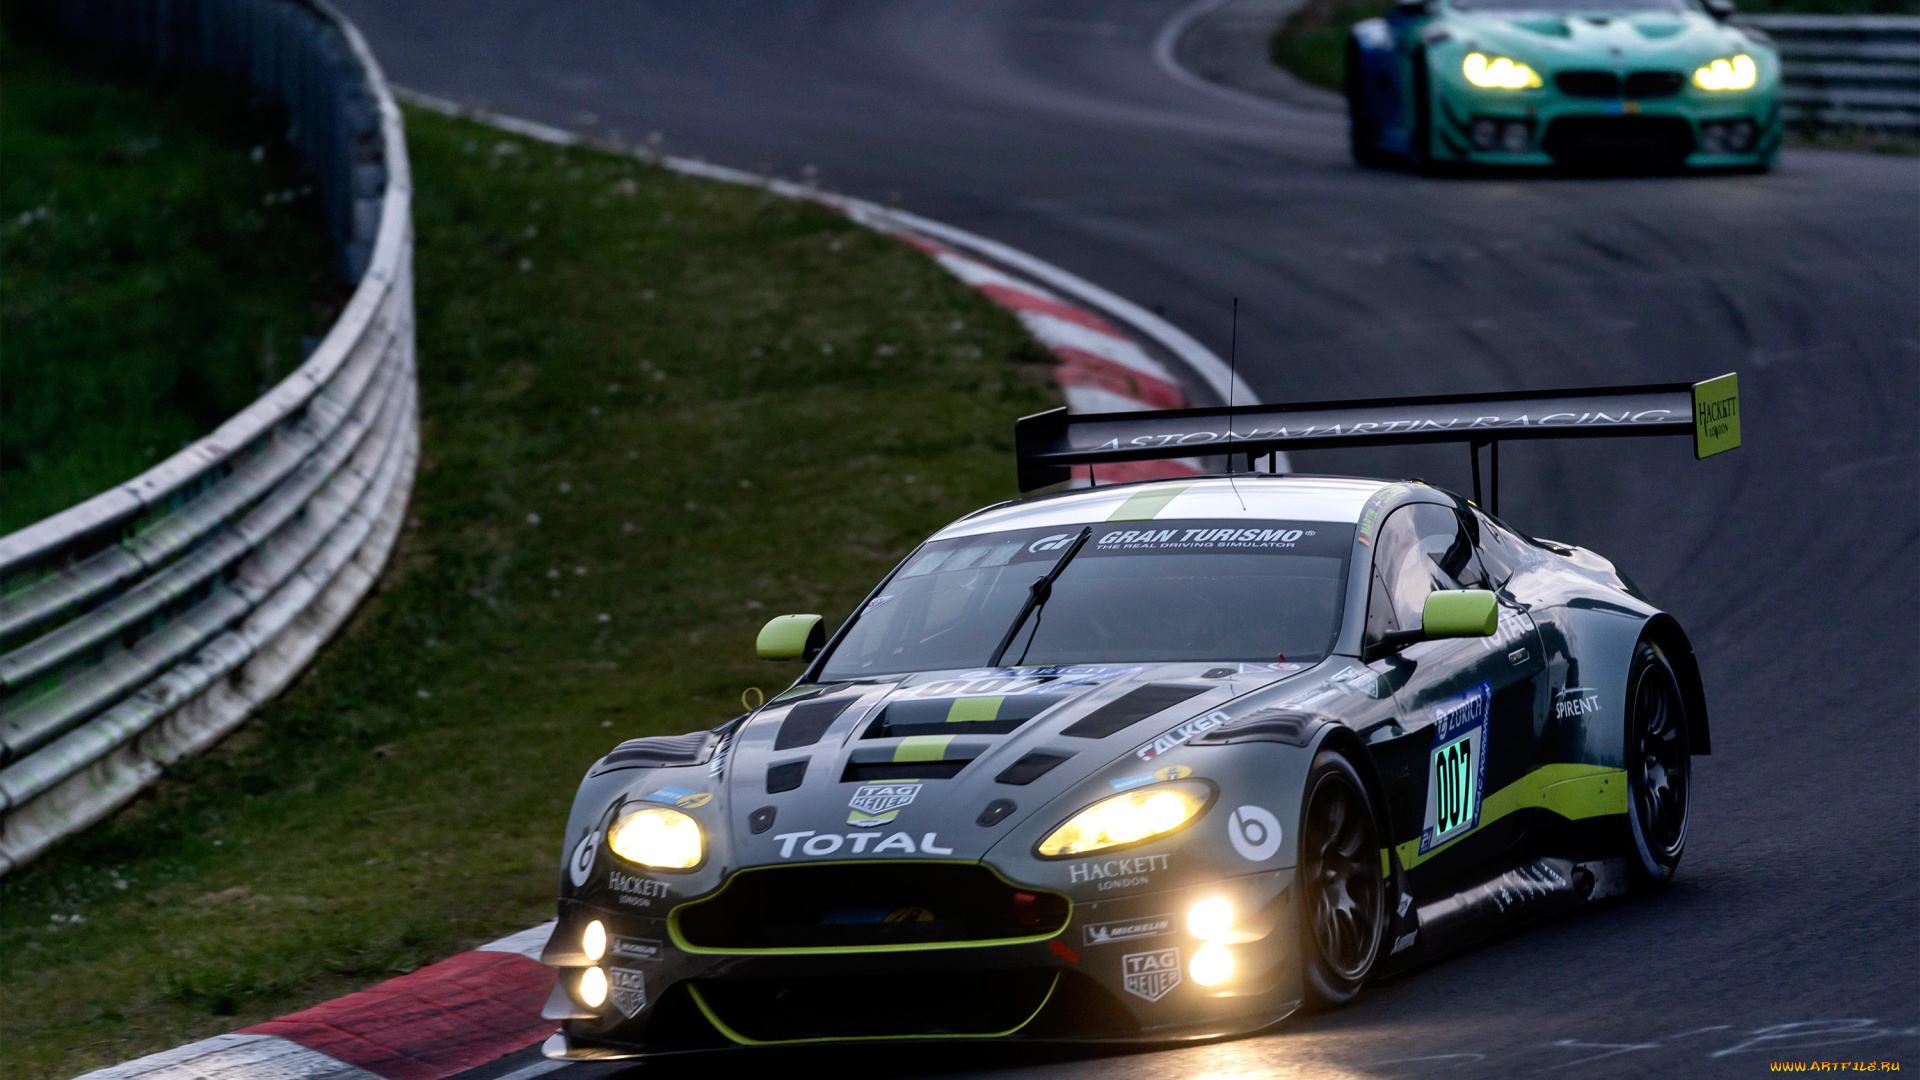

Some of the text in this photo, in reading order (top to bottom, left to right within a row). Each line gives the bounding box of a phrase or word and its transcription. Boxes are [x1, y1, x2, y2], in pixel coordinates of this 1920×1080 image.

[1698, 396, 1737, 426] HACKETT
[1098, 409, 1671, 450] ASTON MARTIN RACING
[1098, 530, 1178, 545] GRAN
[1160, 541, 1214, 549] DRIVING
[916, 676, 1062, 697] 007
[1448, 694, 1483, 731] ZURICH
[1555, 695, 1599, 719] SPIRENT
[1136, 710, 1232, 762] FALKEN
[863, 786, 914, 796] TAG
[1437, 738, 1471, 833] 007
[854, 796, 910, 811] HEUER
[772, 829, 954, 859] TOTAL
[1068, 853, 1171, 884] HACKETT
[608, 870, 672, 899] HACKETT
[1097, 876, 1150, 891] LONDON
[1110, 920, 1169, 936] MICHELIN
[1127, 952, 1175, 973] TAG
[612, 971, 640, 990] TAG
[1127, 972, 1178, 997] HEUER
